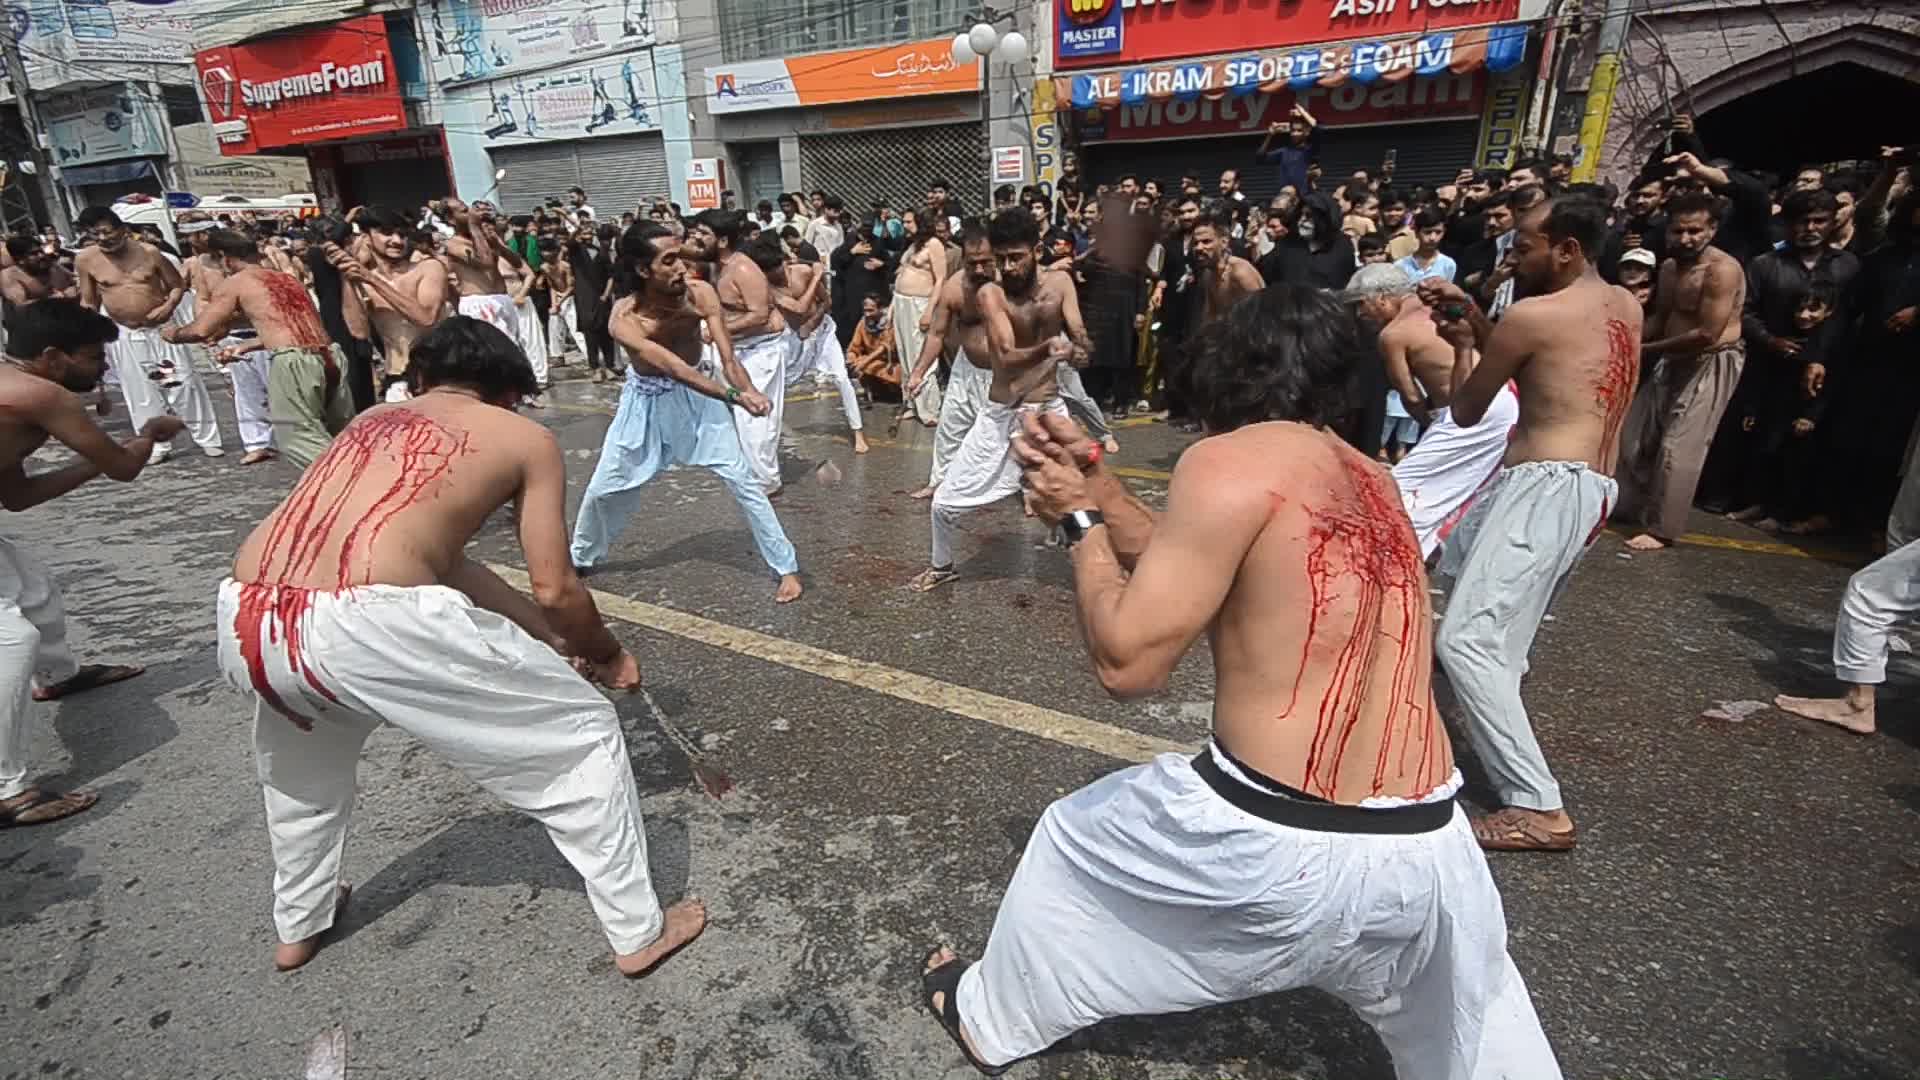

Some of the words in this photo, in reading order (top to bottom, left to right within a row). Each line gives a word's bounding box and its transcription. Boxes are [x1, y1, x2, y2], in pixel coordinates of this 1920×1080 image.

[1063, 26, 1117, 44] MASTER
[1223, 50, 1336, 87] SPORTS
[1355, 38, 1453, 74] FOAM
[690, 183, 715, 200] ATM
